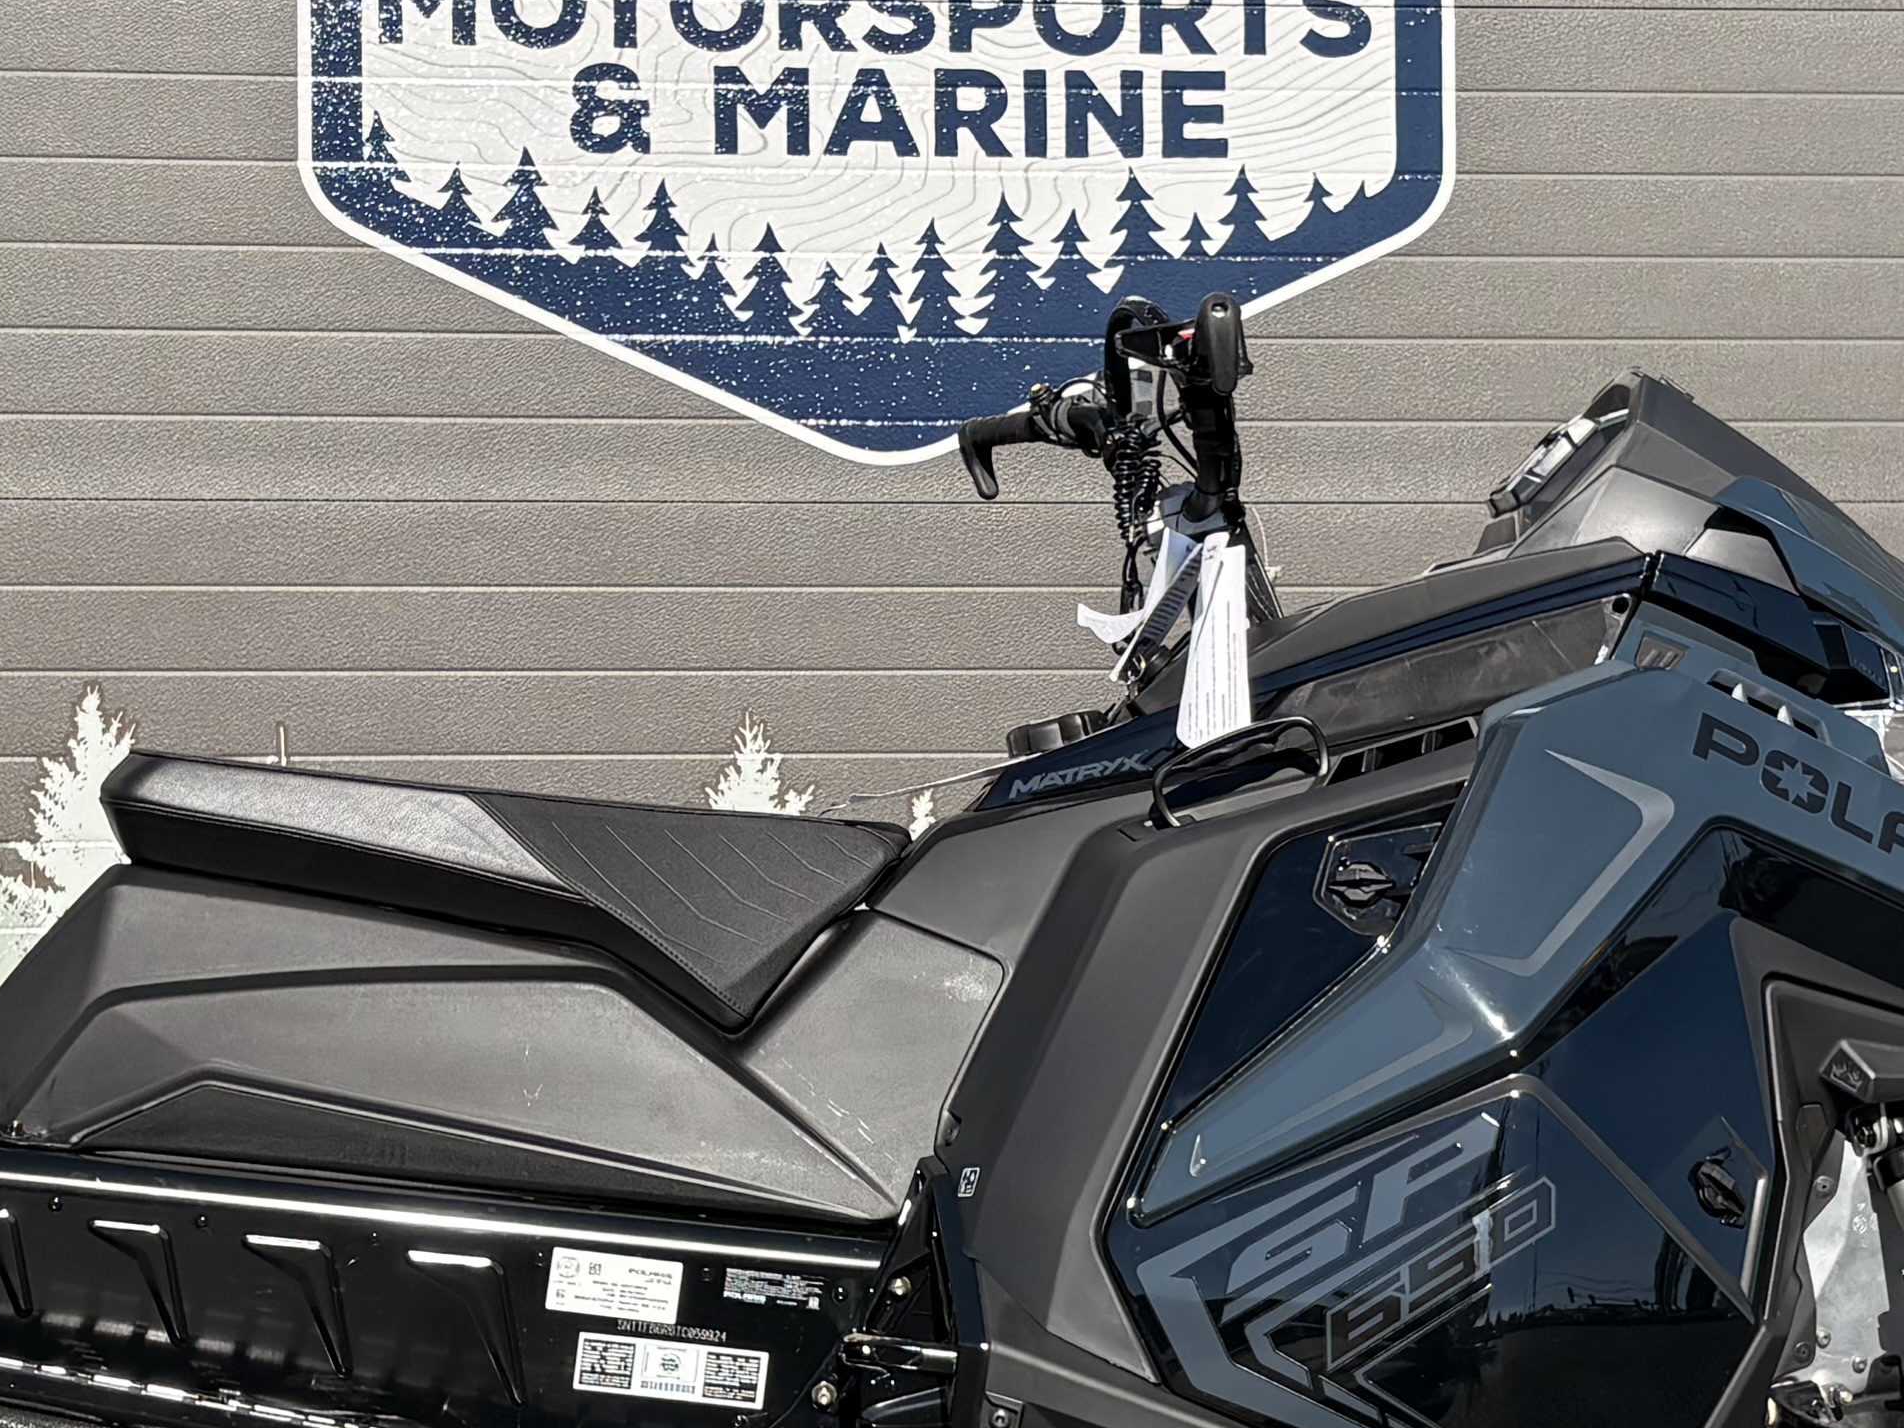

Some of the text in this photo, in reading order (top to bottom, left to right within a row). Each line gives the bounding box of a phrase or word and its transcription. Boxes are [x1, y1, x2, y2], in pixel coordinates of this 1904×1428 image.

[569, 62, 1228, 159] & MARINE
[1008, 750, 1151, 800] MATRYX
[1325, 1177, 1556, 1372] 650
